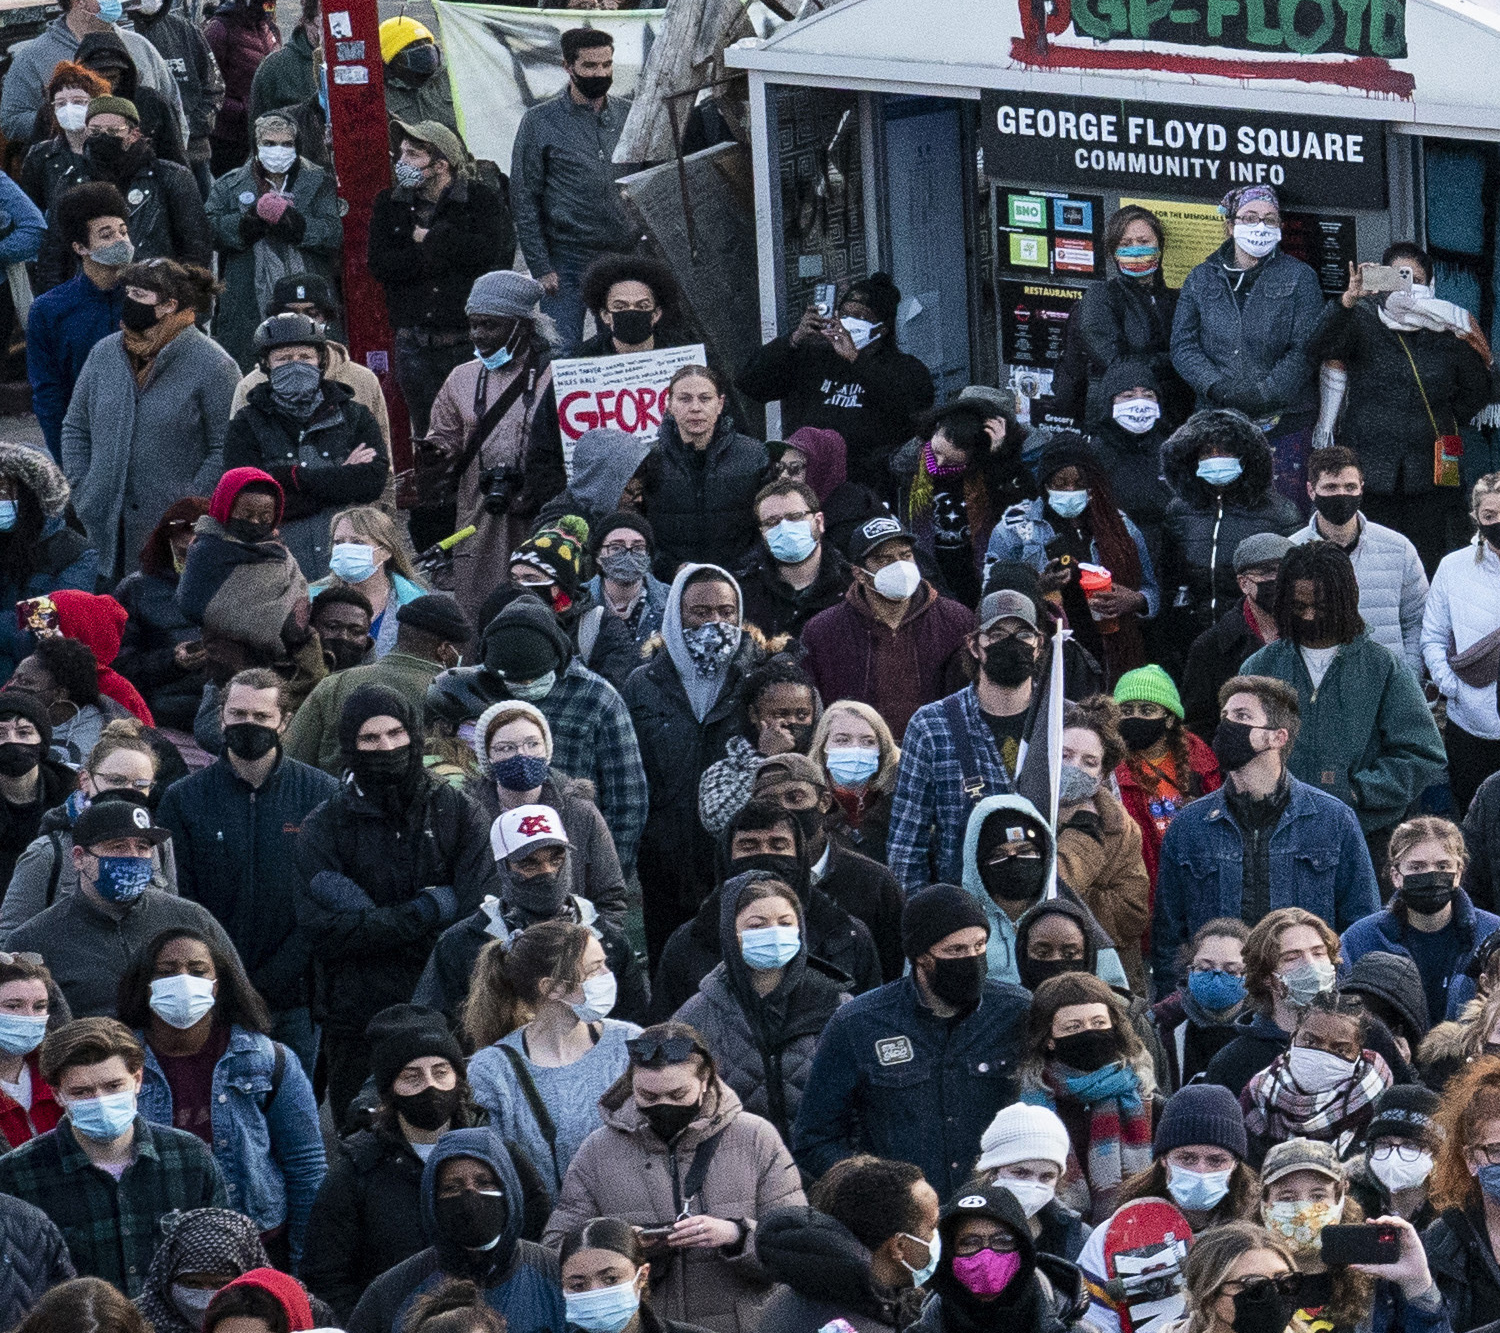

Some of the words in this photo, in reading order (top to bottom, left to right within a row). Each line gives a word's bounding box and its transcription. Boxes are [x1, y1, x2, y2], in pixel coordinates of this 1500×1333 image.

[997, 105, 1098, 145] GEORGE
[1107, 117, 1207, 154] FLOYD
[1216, 127, 1346, 164] SQUARE
[1074, 147, 1200, 179] COMMUNITY
[1207, 161, 1265, 186] INFO
[1022, 284, 1084, 300] RESTAURANTS
